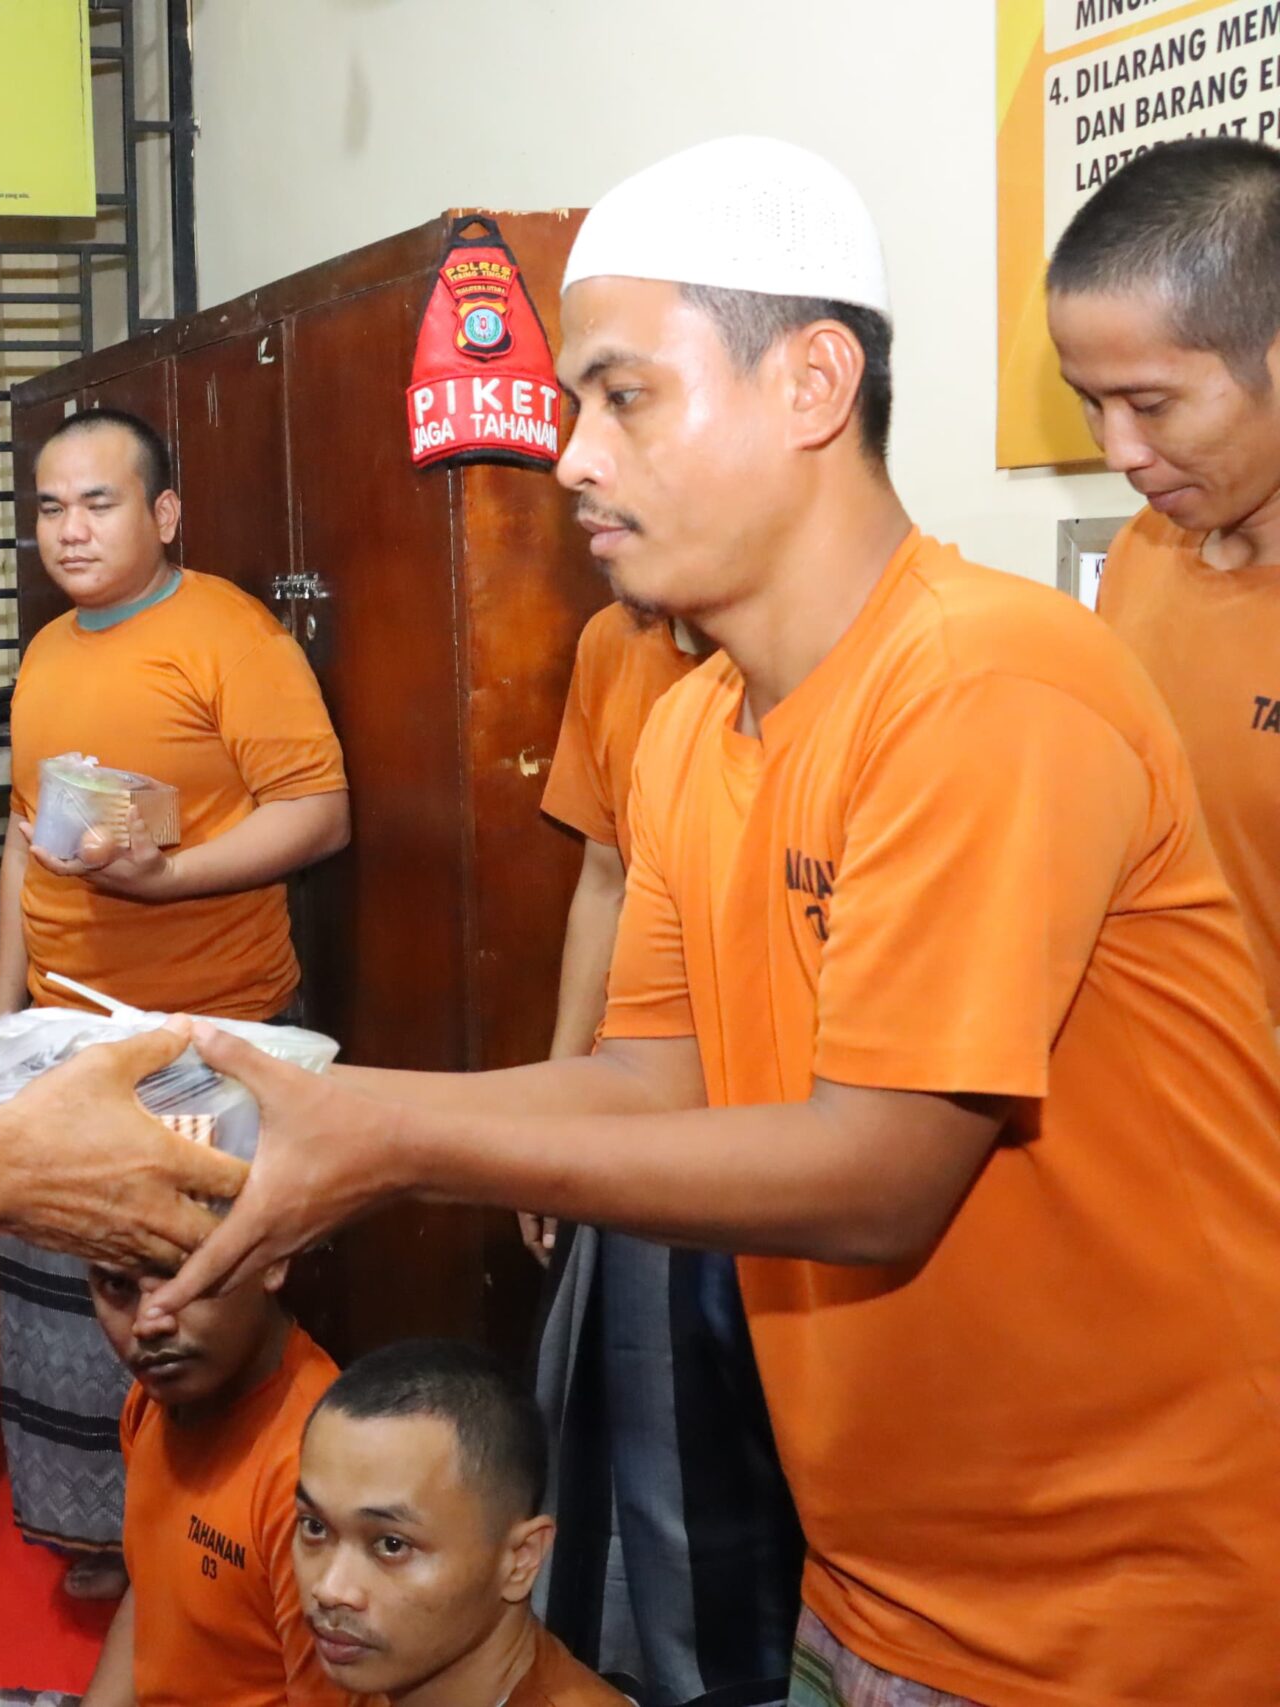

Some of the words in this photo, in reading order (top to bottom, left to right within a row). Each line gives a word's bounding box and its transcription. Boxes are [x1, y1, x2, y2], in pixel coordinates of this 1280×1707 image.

[1049, 77, 1069, 105] 4.
[1077, 28, 1207, 98] DILARANG
[1076, 103, 1125, 146] DAN
[1136, 66, 1248, 128] BARANG
[1260, 54, 1280, 92] E
[1076, 143, 1165, 192] LAPT
[1259, 109, 1280, 142] P
[445, 262, 512, 282] POLRES
[413, 376, 558, 424] PIKET
[413, 417, 456, 455] JAGA
[470, 413, 558, 454] TAHANAN
[188, 1514, 245, 1570] TAHANAN
[201, 1555, 217, 1579] 03
